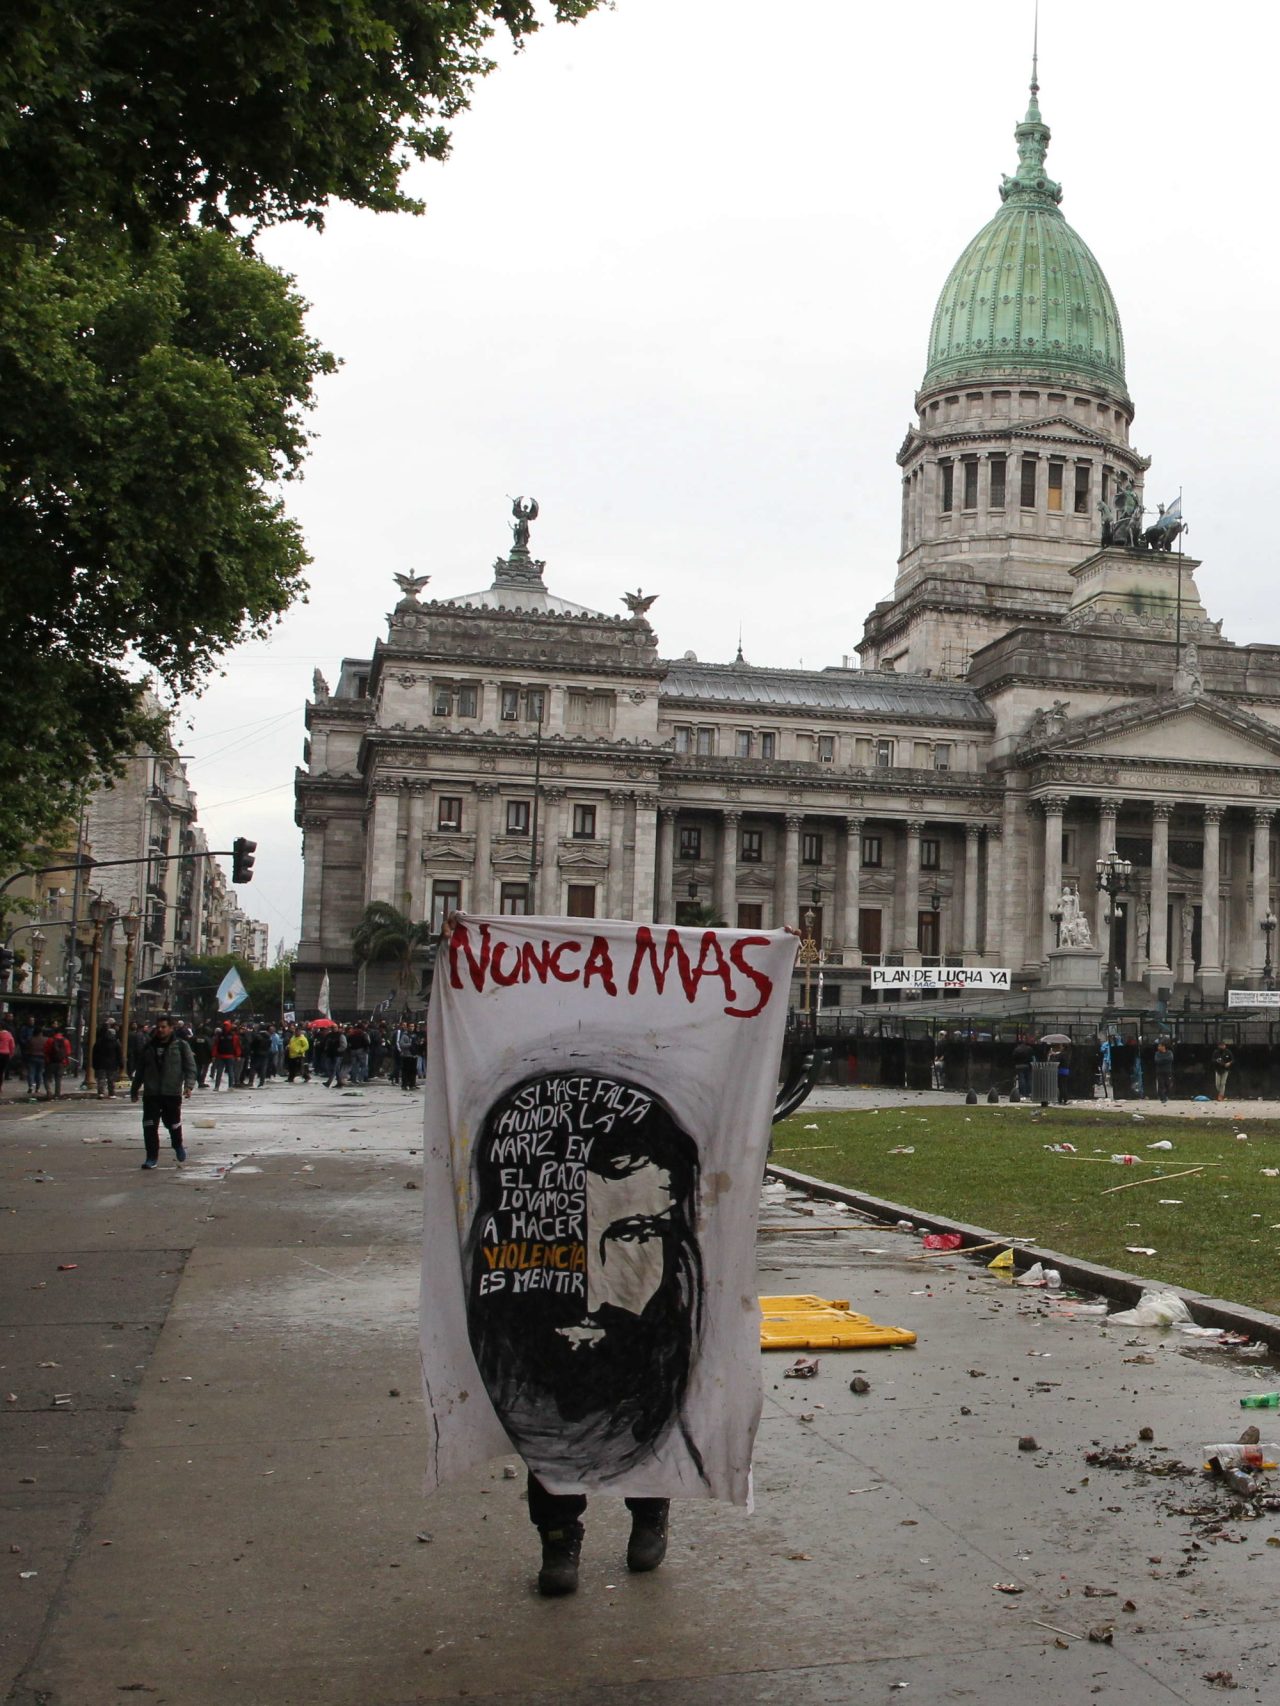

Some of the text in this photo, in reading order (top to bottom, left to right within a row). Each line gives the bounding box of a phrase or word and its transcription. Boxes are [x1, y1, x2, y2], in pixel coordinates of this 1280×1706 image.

[628, 926, 774, 1018] MAS
[873, 969, 1008, 984] PLAN DE LUCHA YA
[515, 1078, 652, 1124] SI HACE FALTA
[498, 1103, 616, 1134] HUNDIR LA
[490, 1130, 595, 1164] NARIZ EN
[500, 1161, 586, 1190] EL PLATO
[484, 1211, 583, 1244] A HACER
[479, 1267, 585, 1298] ES MENTIR
